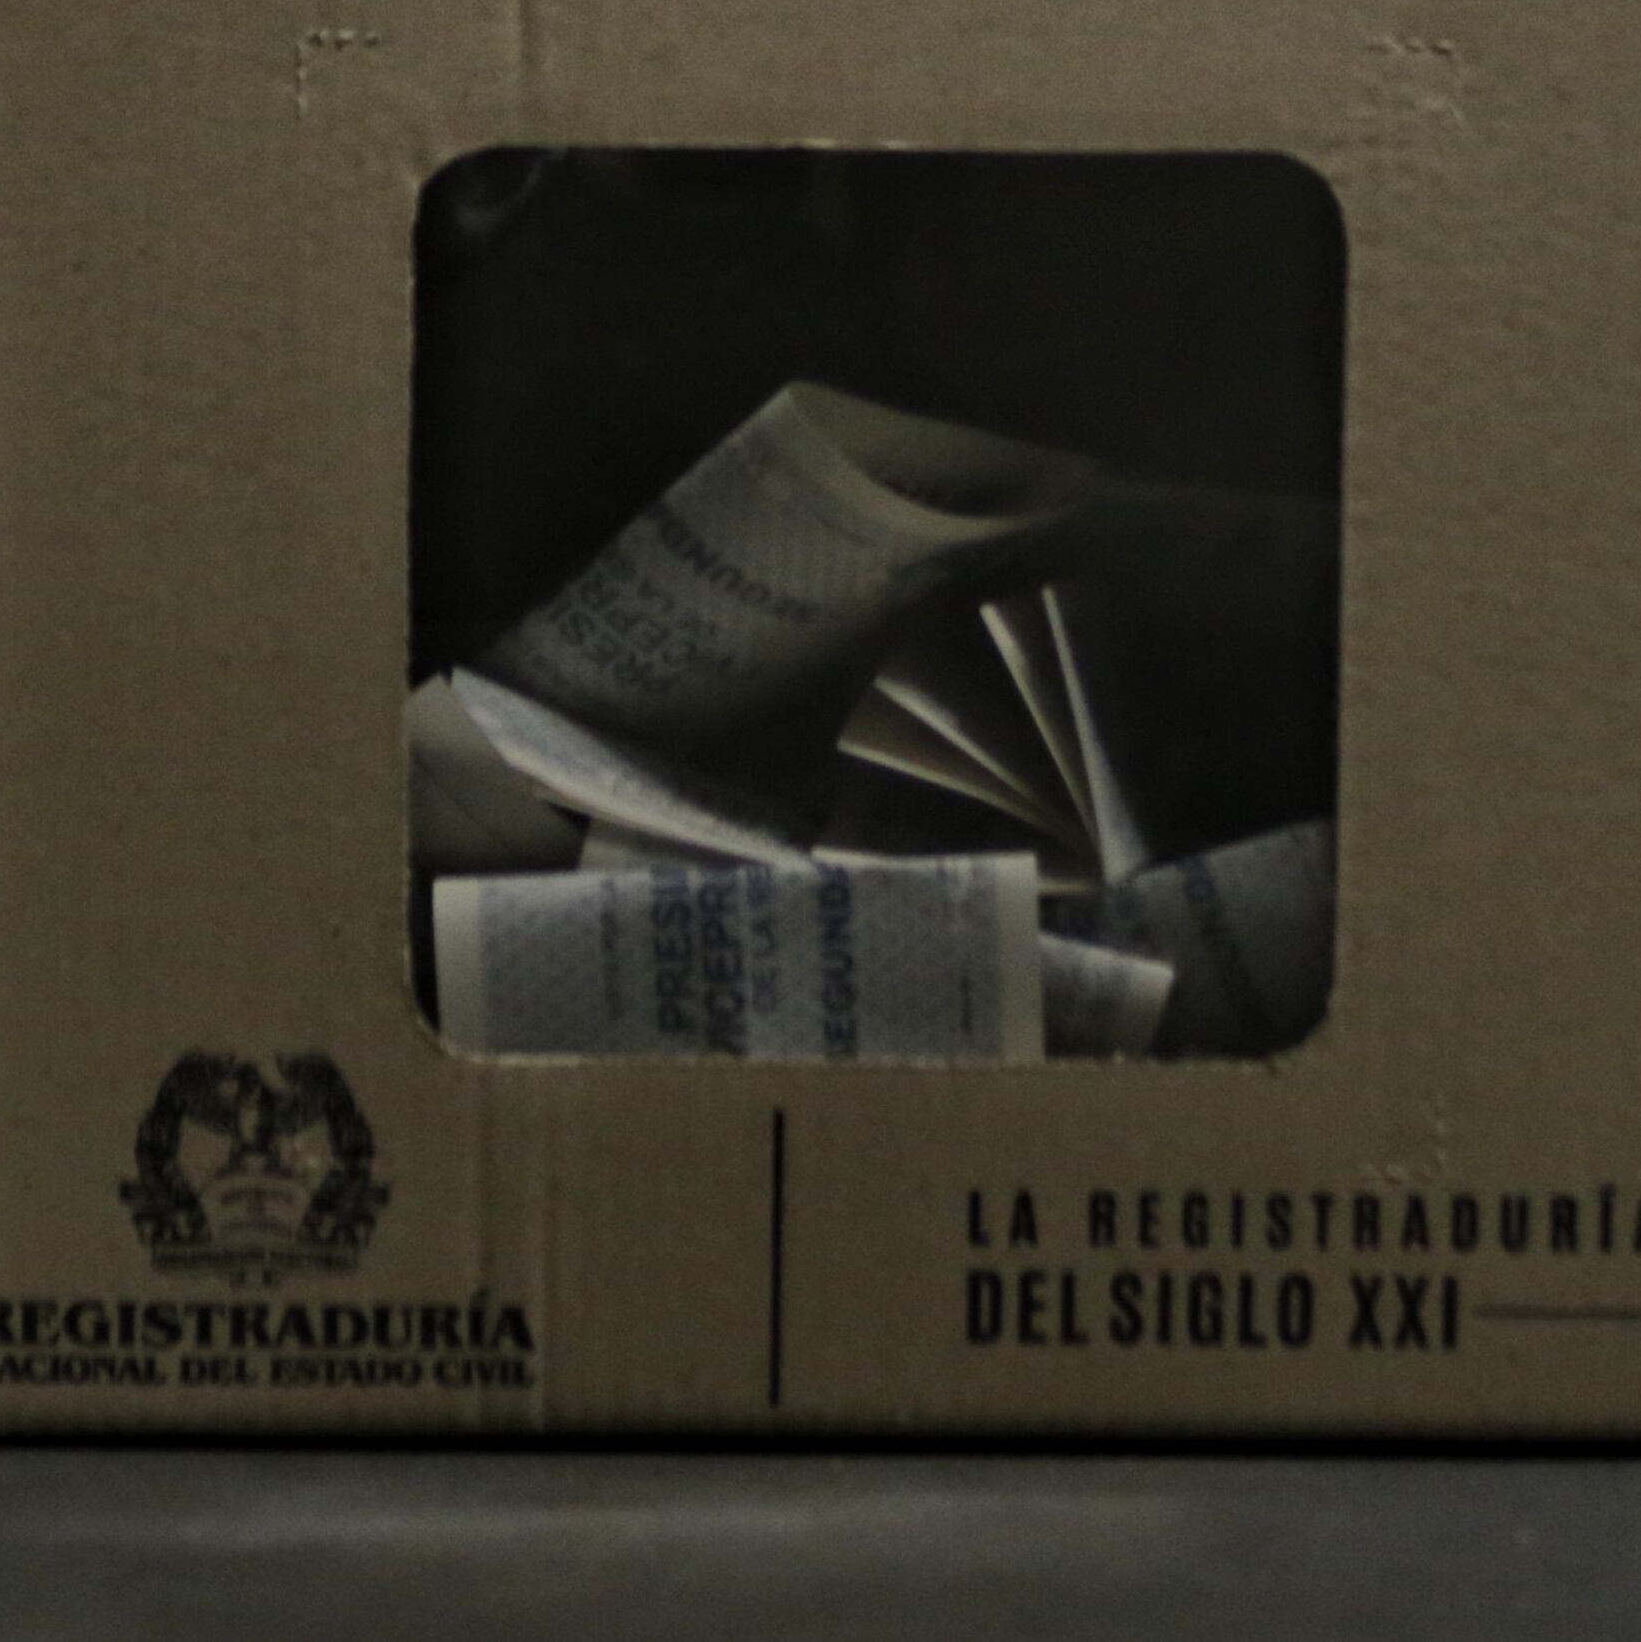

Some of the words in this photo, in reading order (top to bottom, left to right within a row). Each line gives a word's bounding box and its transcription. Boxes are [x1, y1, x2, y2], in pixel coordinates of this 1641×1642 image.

[967, 1188, 1039, 1249] LA
[965, 1269, 1089, 1348] DEL
[1107, 1270, 1316, 1351] SIGLO
[1348, 1273, 1459, 1351] XXI
[179, 1356, 259, 1386] DEL
[270, 1356, 422, 1387] ESTADO
[432, 1356, 536, 1387] CIVIL
